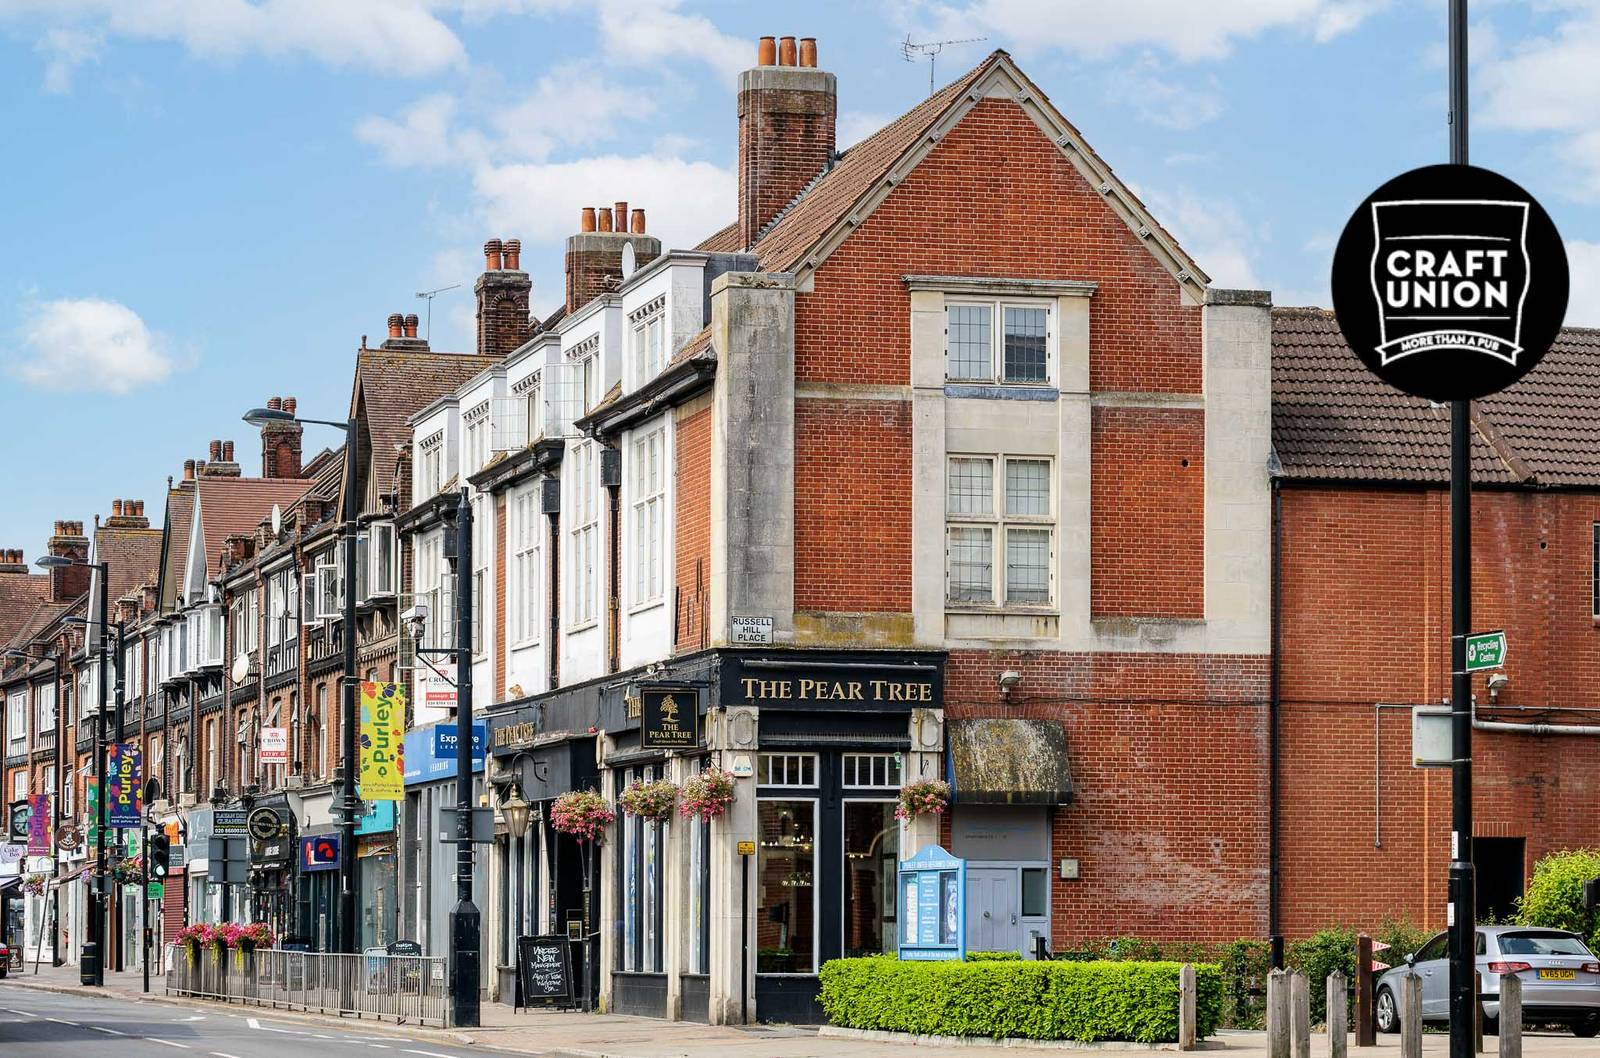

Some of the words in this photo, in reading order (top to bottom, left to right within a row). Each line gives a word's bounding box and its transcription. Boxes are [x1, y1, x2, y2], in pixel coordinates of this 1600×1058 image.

[732, 617, 771, 626] RUSSELL
[742, 625, 761, 634] HILL
[737, 633, 766, 642] PLACE
[1477, 640, 1498, 651] Recycling
[1480, 652, 1495, 662] Centre
[741, 678, 792, 699] THE
[798, 679, 864, 700] PEAR
[870, 680, 932, 701] TREE
[373, 696, 393, 763] Purley
[662, 723, 679, 731] THE
[440, 733, 480, 744] Expe
[649, 730, 670, 739] PEAR
[671, 730, 692, 739] TREE
[118, 754, 134, 805] Purley
